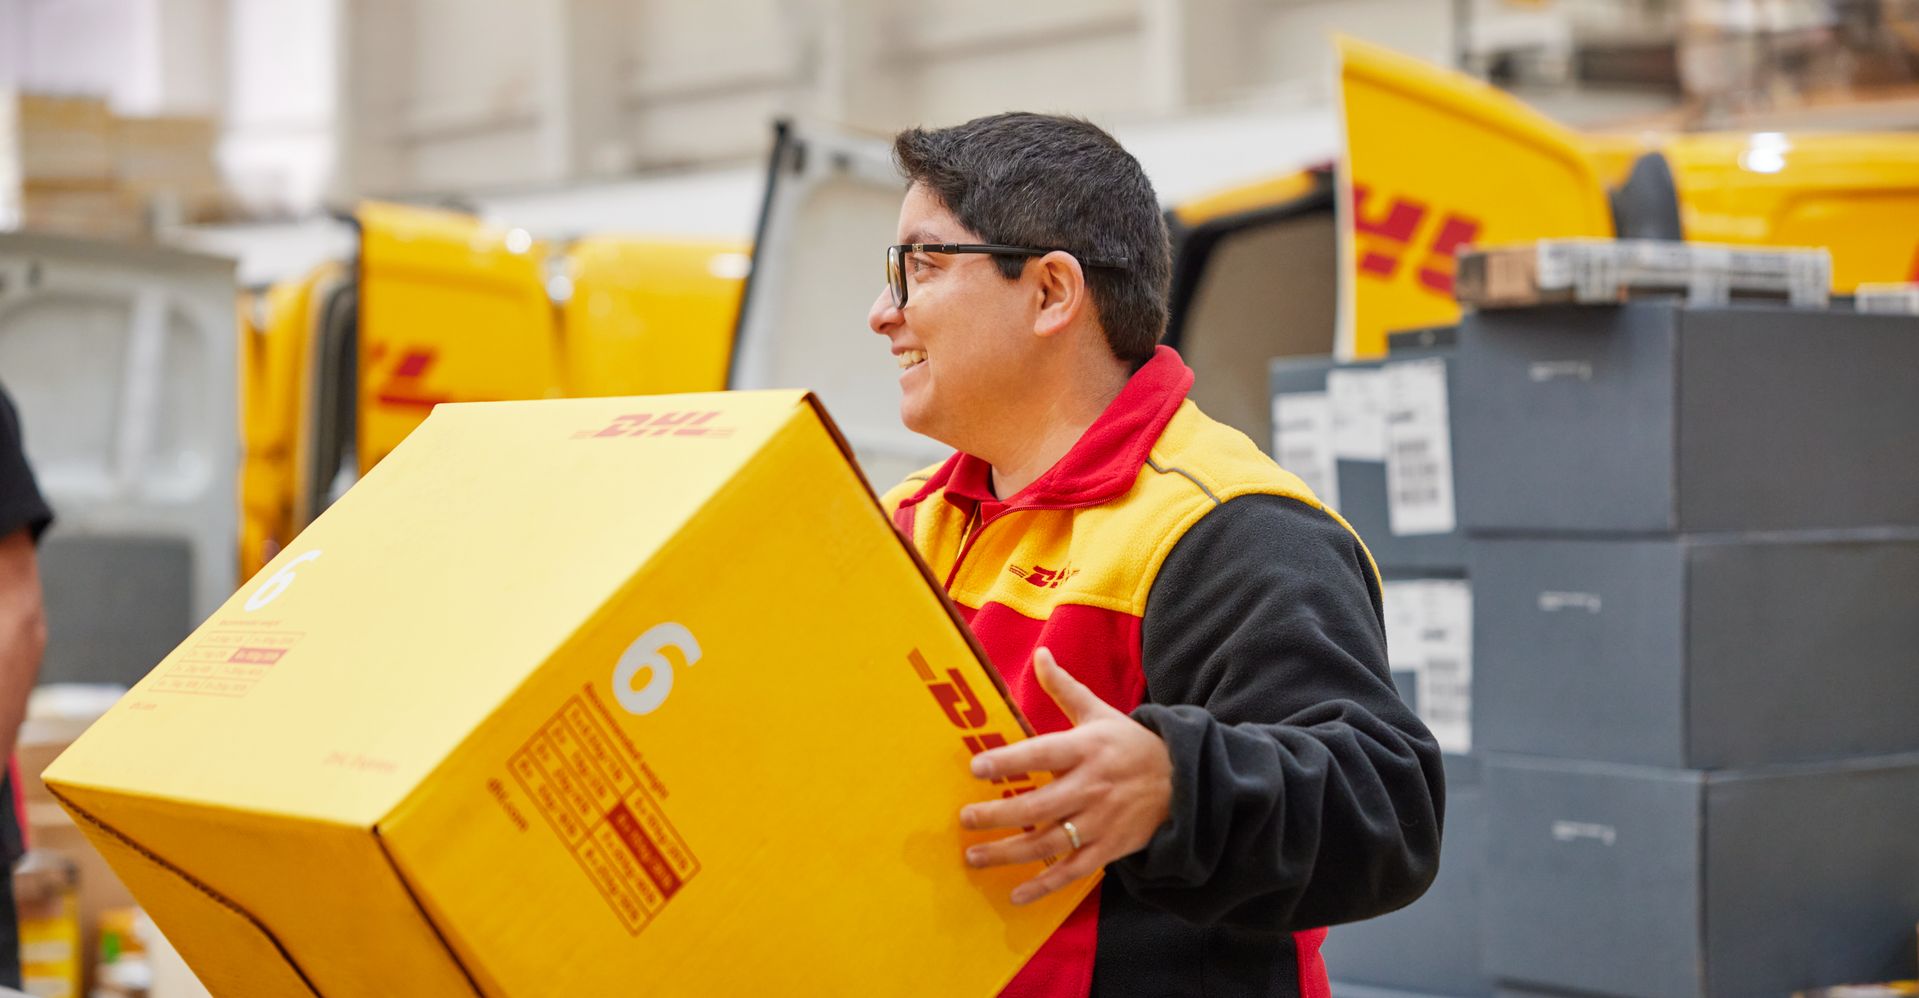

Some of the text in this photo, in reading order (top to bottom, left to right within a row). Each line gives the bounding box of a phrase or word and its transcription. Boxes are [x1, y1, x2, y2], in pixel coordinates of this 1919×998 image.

[593, 410, 722, 437] DHL
[244, 549, 323, 612] 6
[612, 621, 703, 715] 6
